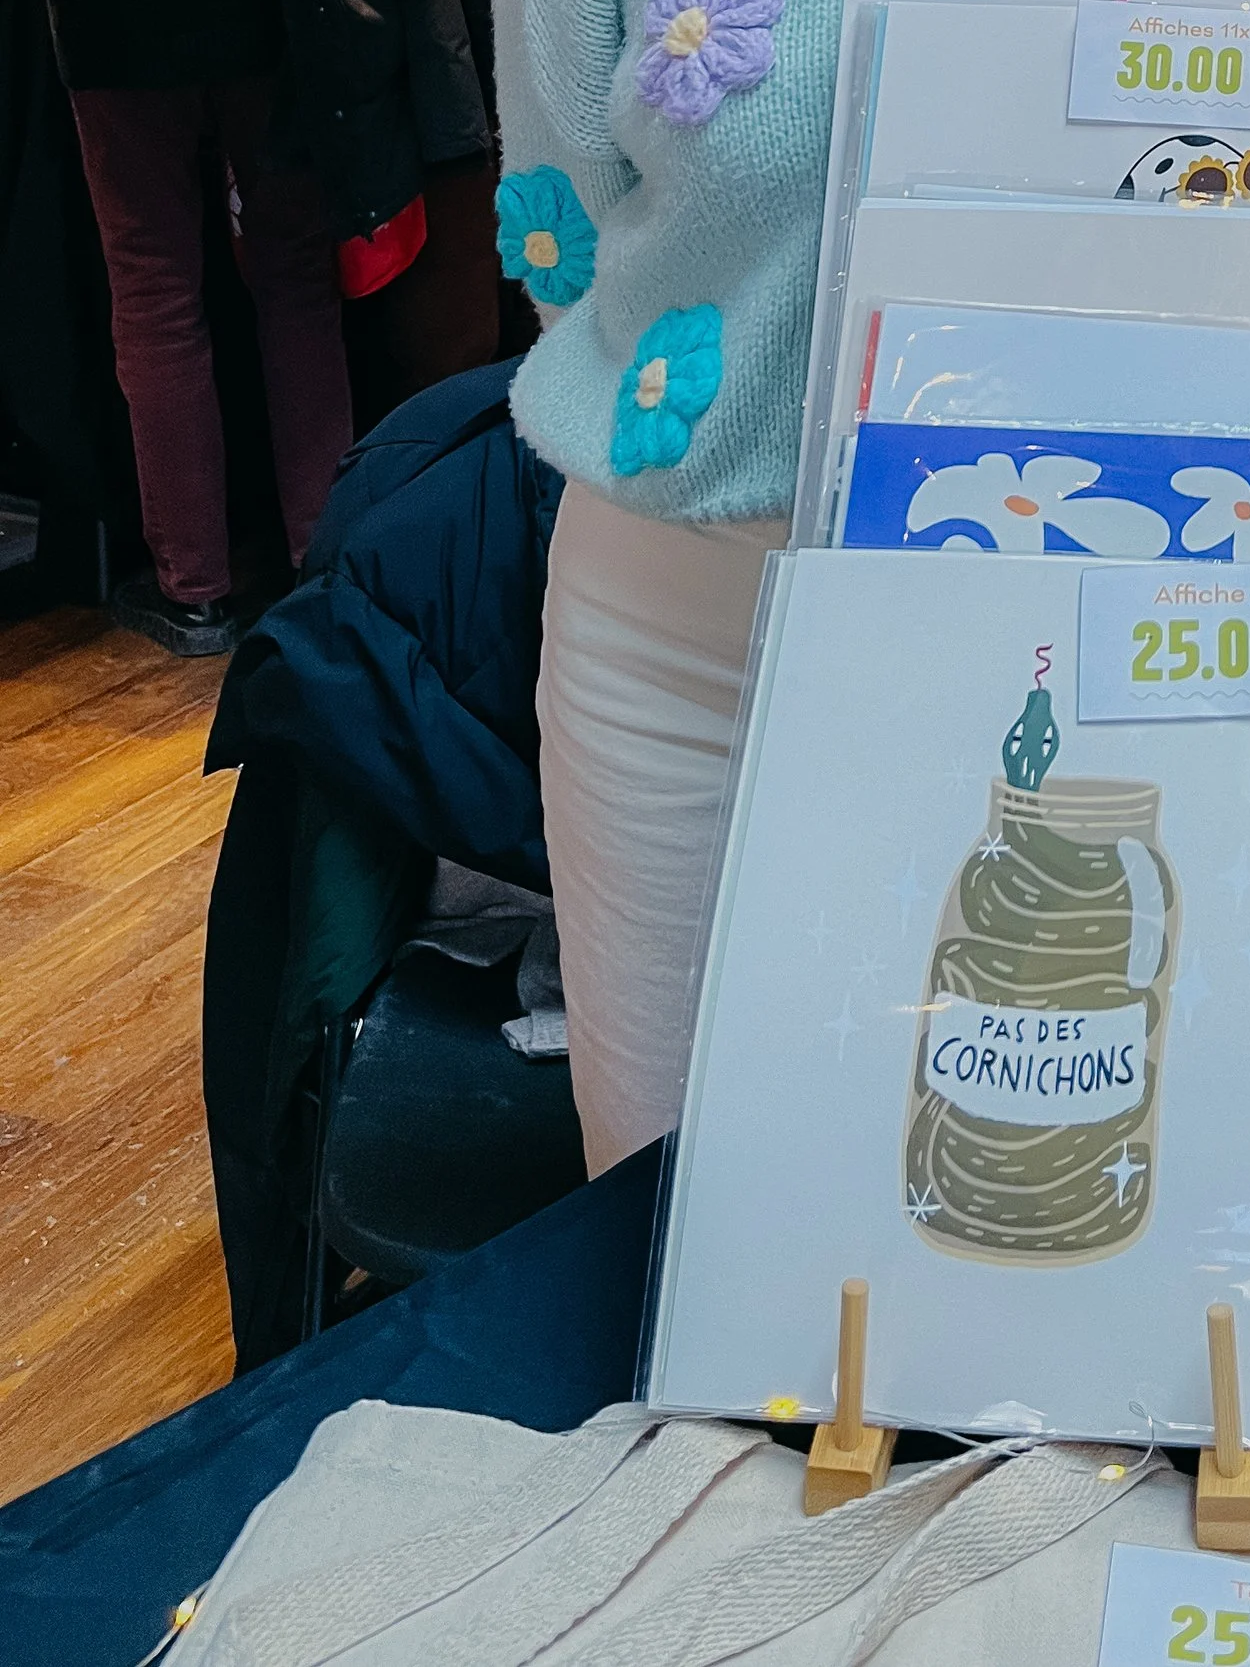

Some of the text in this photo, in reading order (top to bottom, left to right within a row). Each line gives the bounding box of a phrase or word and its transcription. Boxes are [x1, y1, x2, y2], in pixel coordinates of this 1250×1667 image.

[1128, 17, 1214, 38] Affiches
[1116, 40, 1243, 95] 30.00
[1154, 582, 1245, 605] Affiche
[979, 1015, 1086, 1043] PAS DES
[932, 1037, 1134, 1096] CORNICHONS
